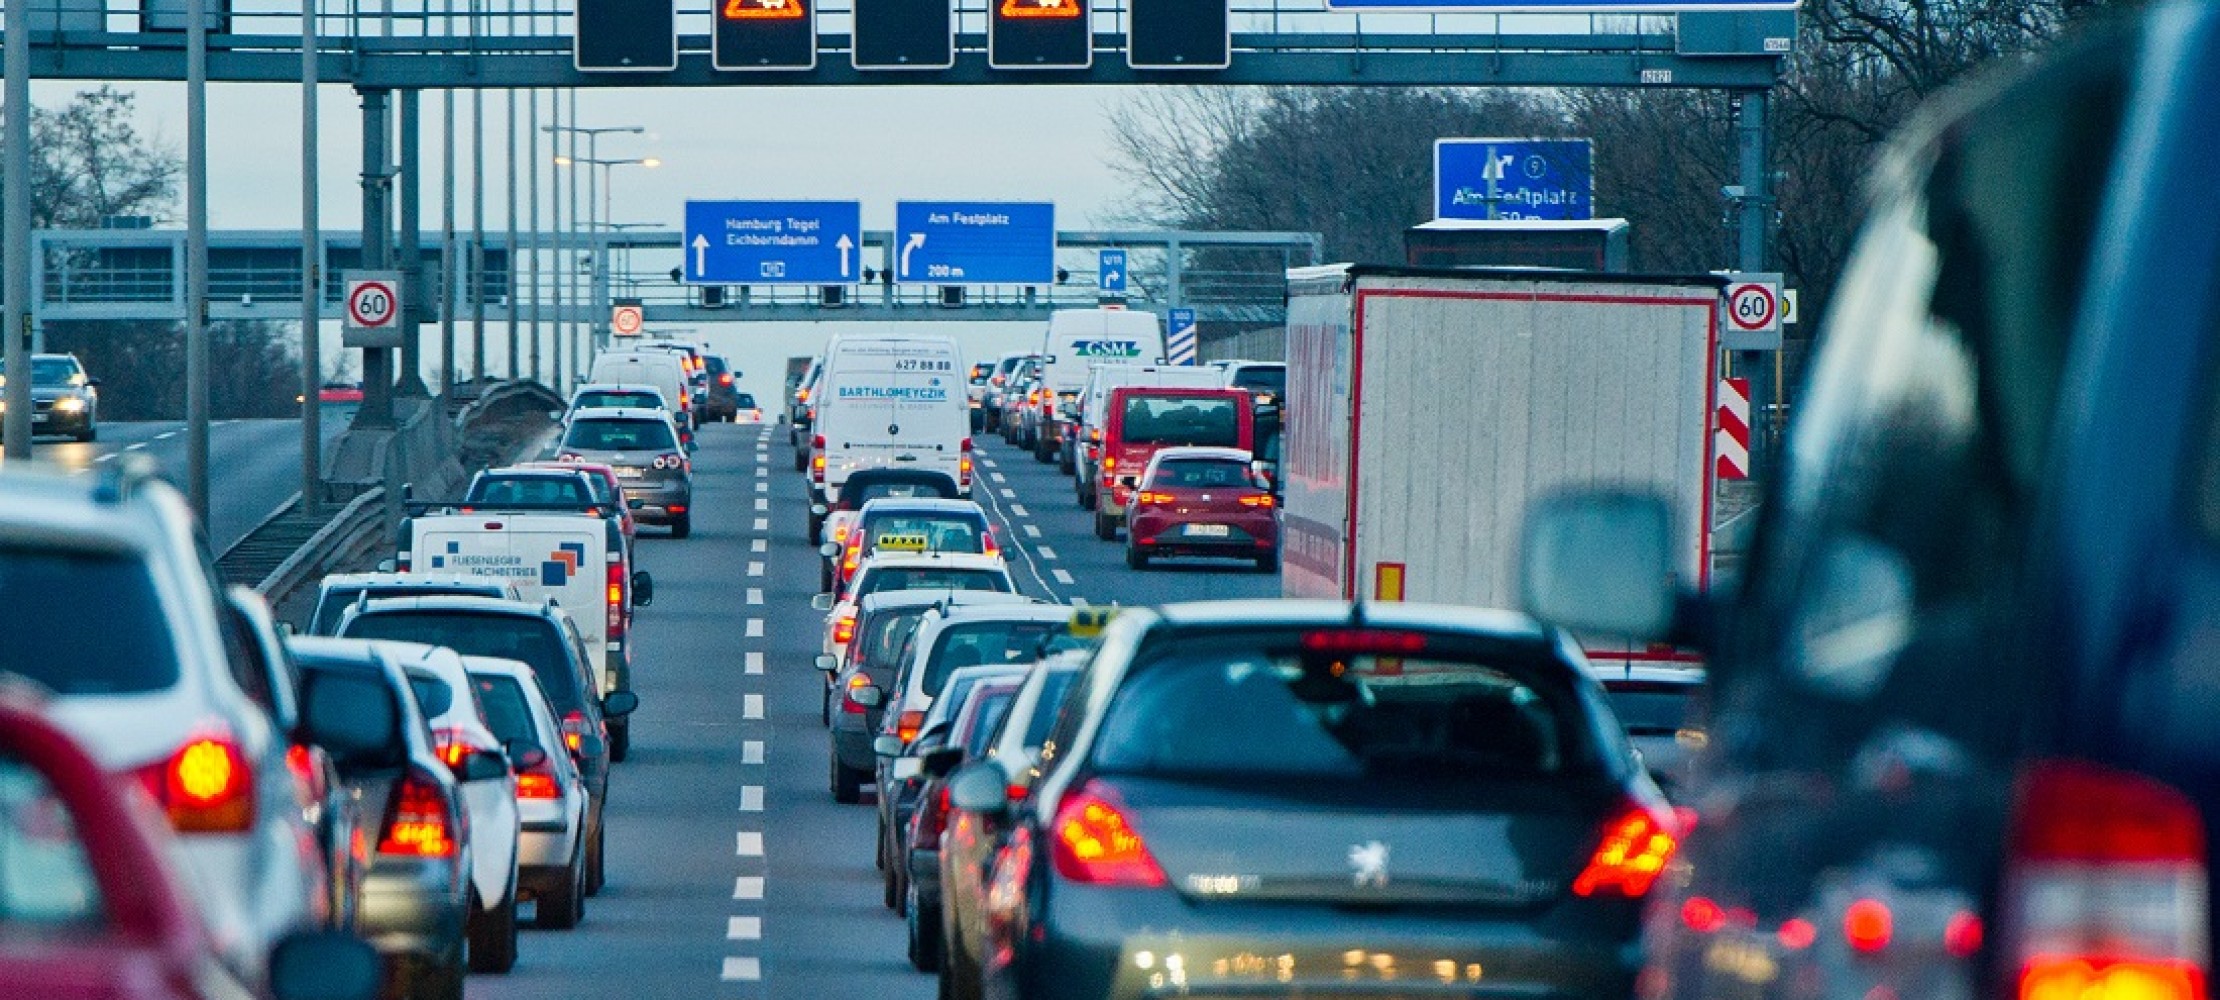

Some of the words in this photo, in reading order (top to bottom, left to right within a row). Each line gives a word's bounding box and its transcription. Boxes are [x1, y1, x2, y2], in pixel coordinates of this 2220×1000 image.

[1531, 160, 1539, 173] 9
[725, 217, 782, 232] Hamburg
[786, 217, 820, 232] Tegel
[928, 212, 949, 224] Am
[953, 211, 1010, 226] Festplatz
[726, 233, 820, 245] Eichborndamm
[928, 264, 949, 278] 200
[951, 267, 964, 277] m
[360, 294, 386, 315] 60
[1739, 296, 1765, 318] 60
[1087, 341, 1127, 355] GSM
[895, 359, 917, 371] 627
[452, 556, 522, 566] FLIESENLEGER
[471, 567, 538, 577] FACHBETRIEB
